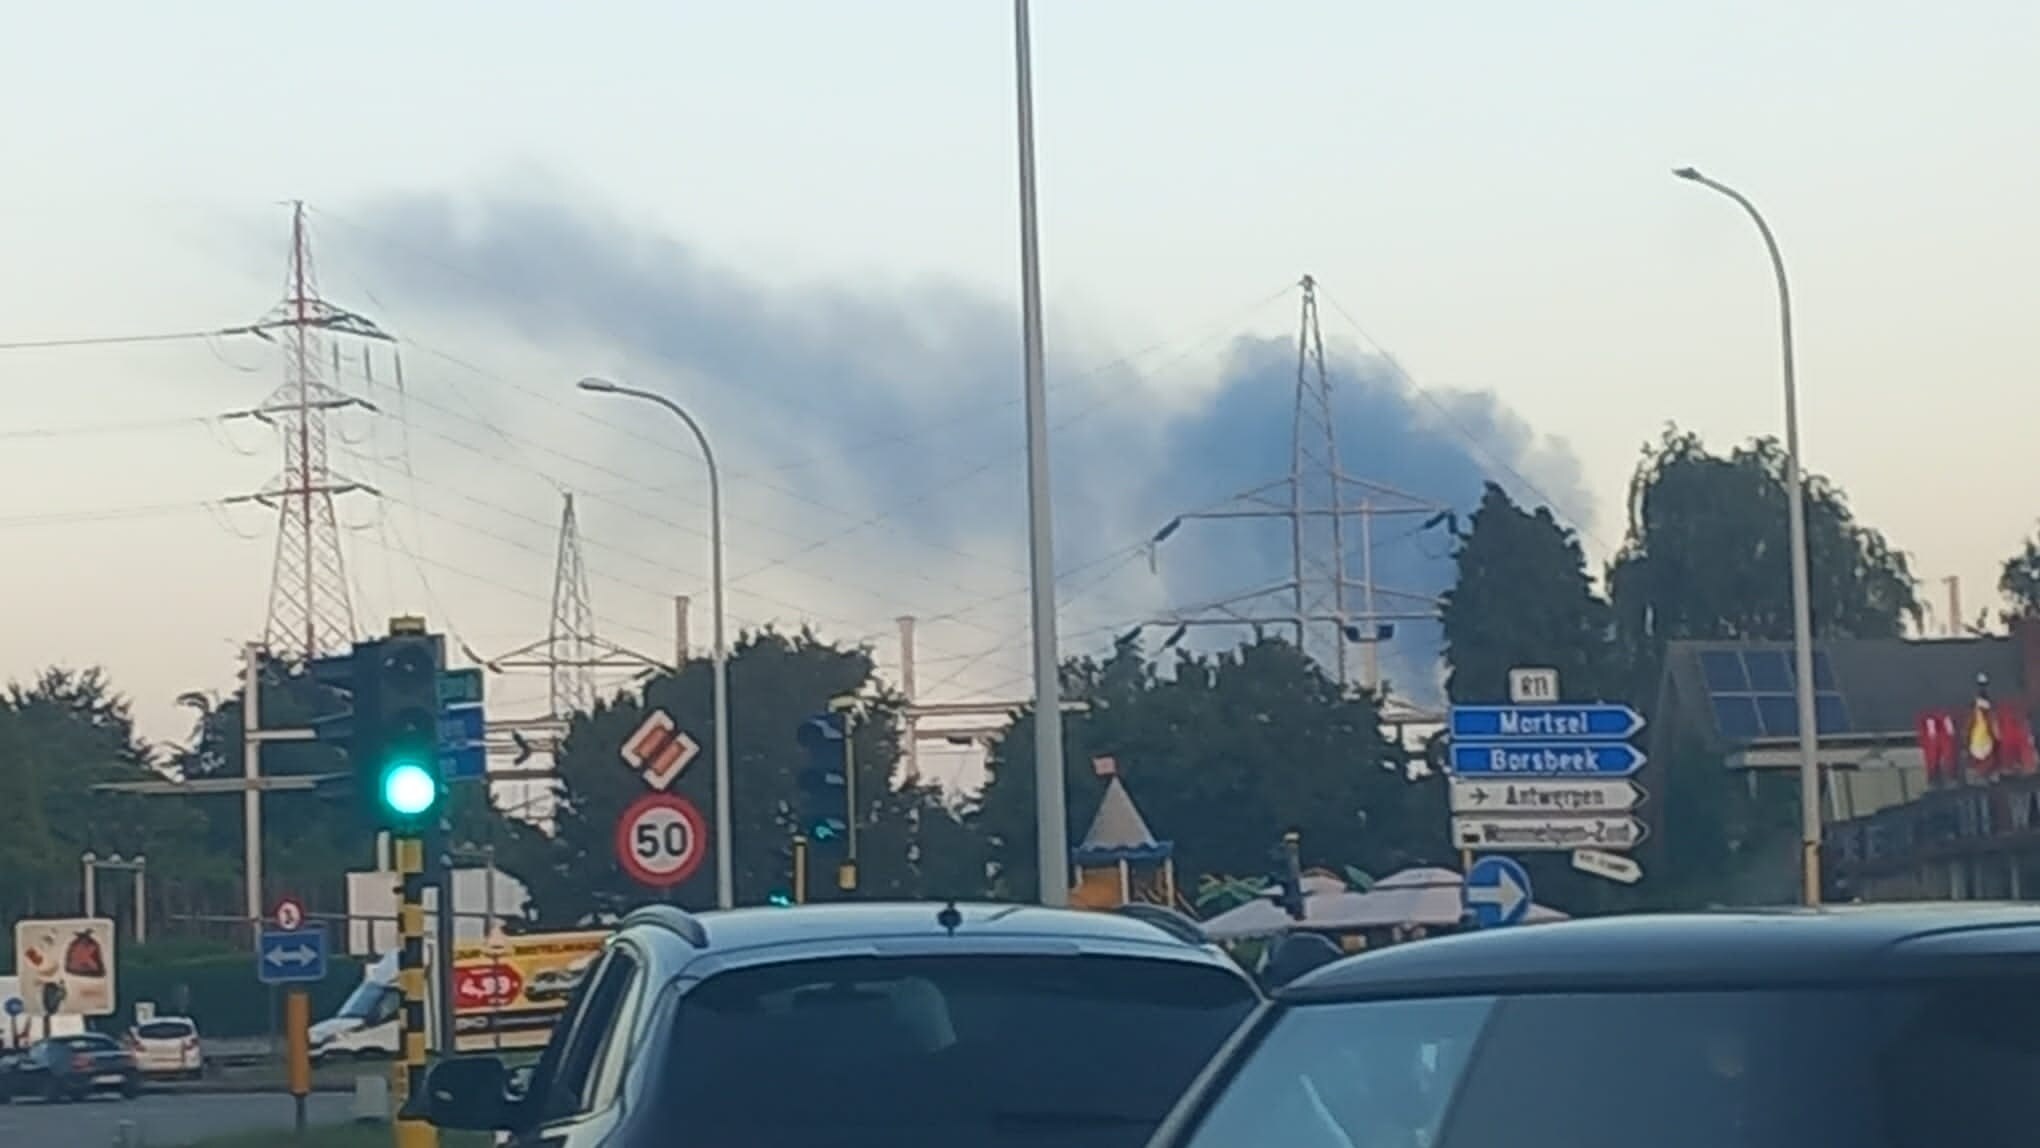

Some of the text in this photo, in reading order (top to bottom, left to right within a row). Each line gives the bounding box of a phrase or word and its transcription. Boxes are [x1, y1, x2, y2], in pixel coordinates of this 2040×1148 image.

[1520, 675, 1549, 697] R11
[1500, 711, 1588, 734] Mortsel
[1489, 748, 1600, 771] Borsbeek
[1506, 784, 1604, 809] Antwerpen
[637, 821, 688, 858] 50
